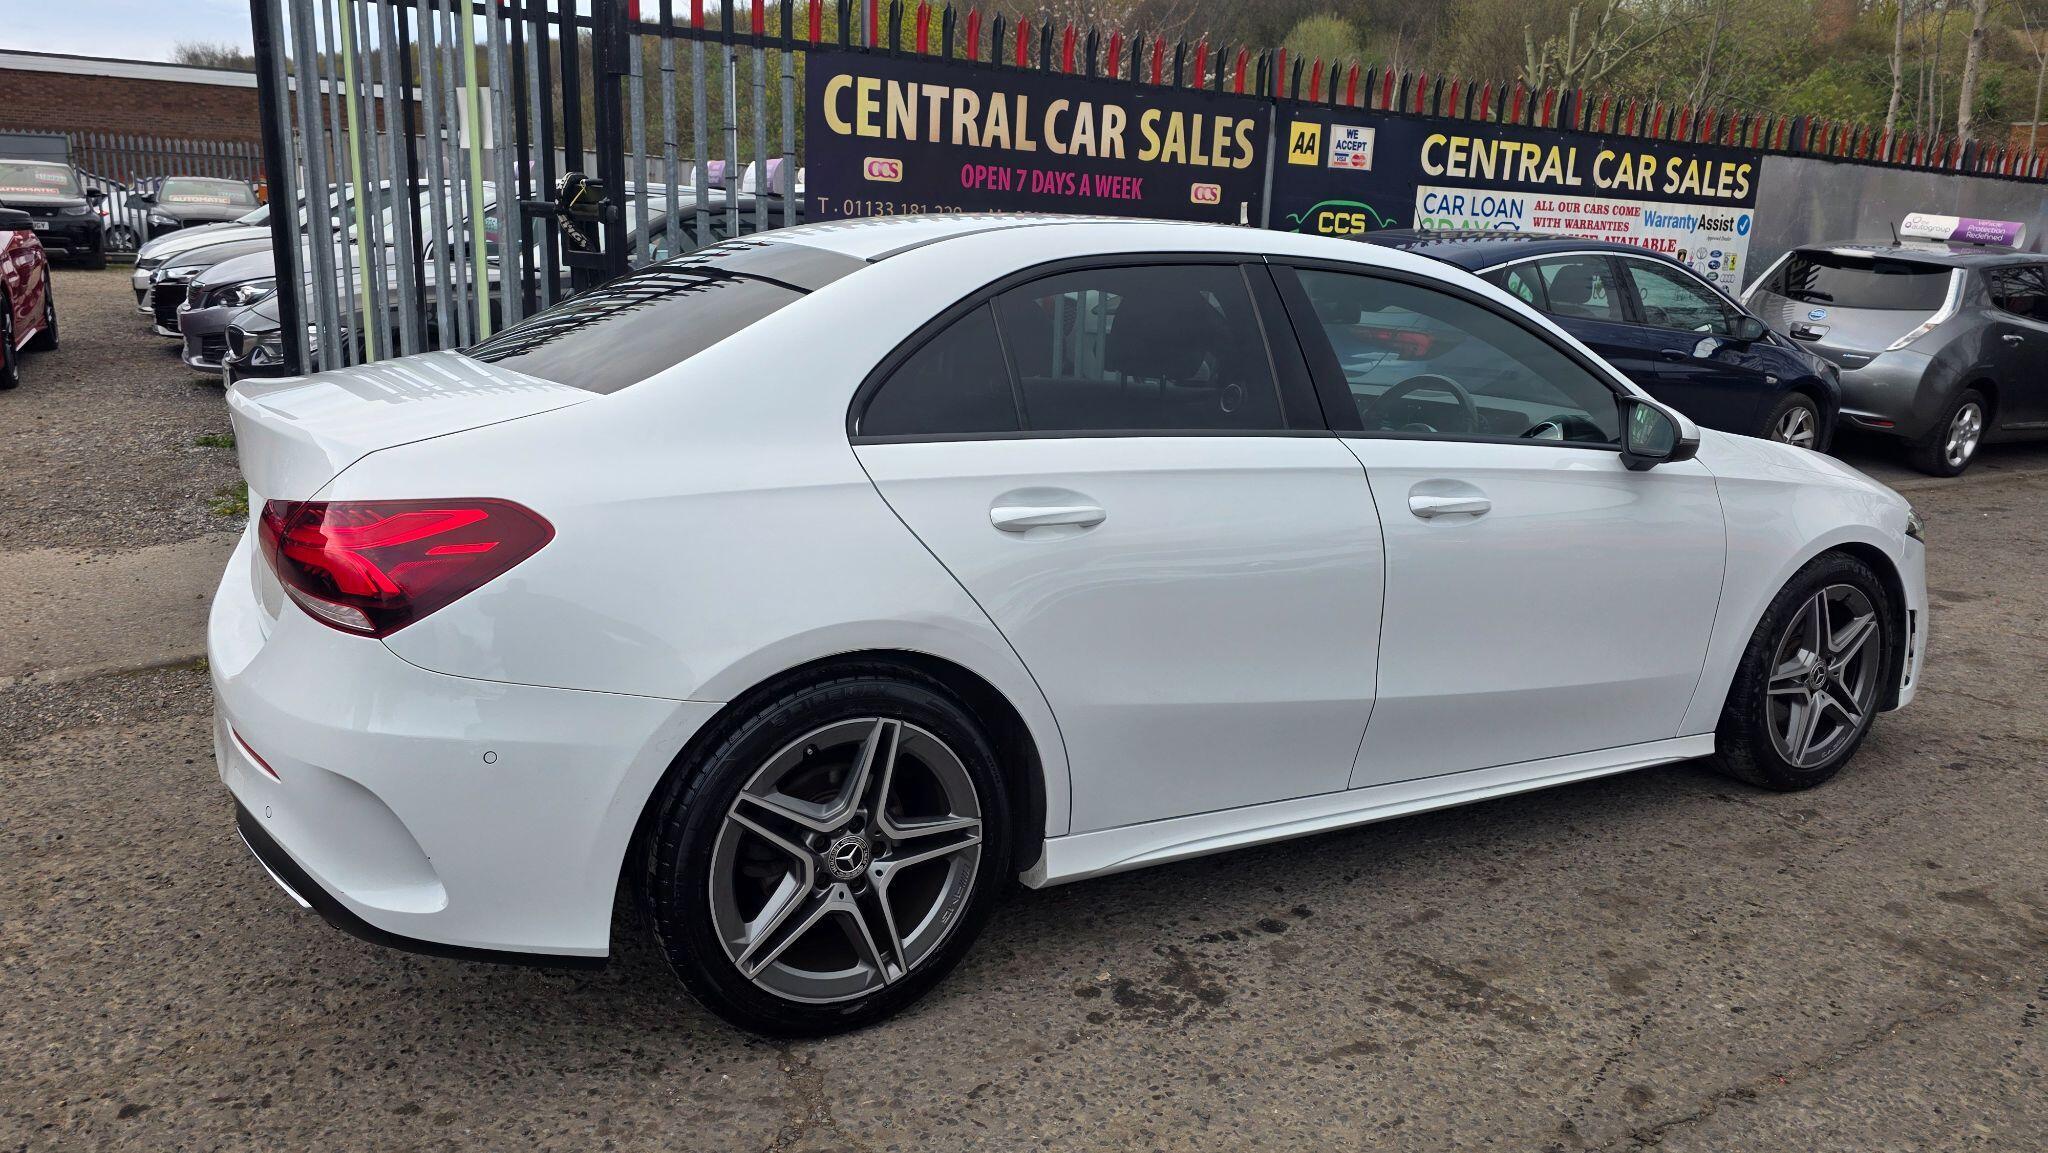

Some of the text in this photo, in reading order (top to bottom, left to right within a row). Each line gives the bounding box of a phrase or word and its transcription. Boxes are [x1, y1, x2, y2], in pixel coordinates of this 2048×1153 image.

[824, 74, 1255, 170] CENTRAL CAR SALES
[1346, 128, 1359, 139] WE
[1292, 131, 1317, 155] AA
[1336, 139, 1367, 151] ACCEPT
[1420, 133, 1752, 200] CENTRAL CAR SALES
[961, 163, 1144, 200] OPEN 7 DAYS A WEEK
[843, 199, 894, 217] 01133
[1423, 192, 1524, 219] CAR LOAN
[1534, 200, 1641, 217] ALL OUR CARS COME
[1318, 211, 1366, 235] CCS
[1533, 217, 1630, 232] WITH WARRANTIES
[1967, 224, 2006, 234] Protection
[1966, 232, 2004, 241] Redefined
